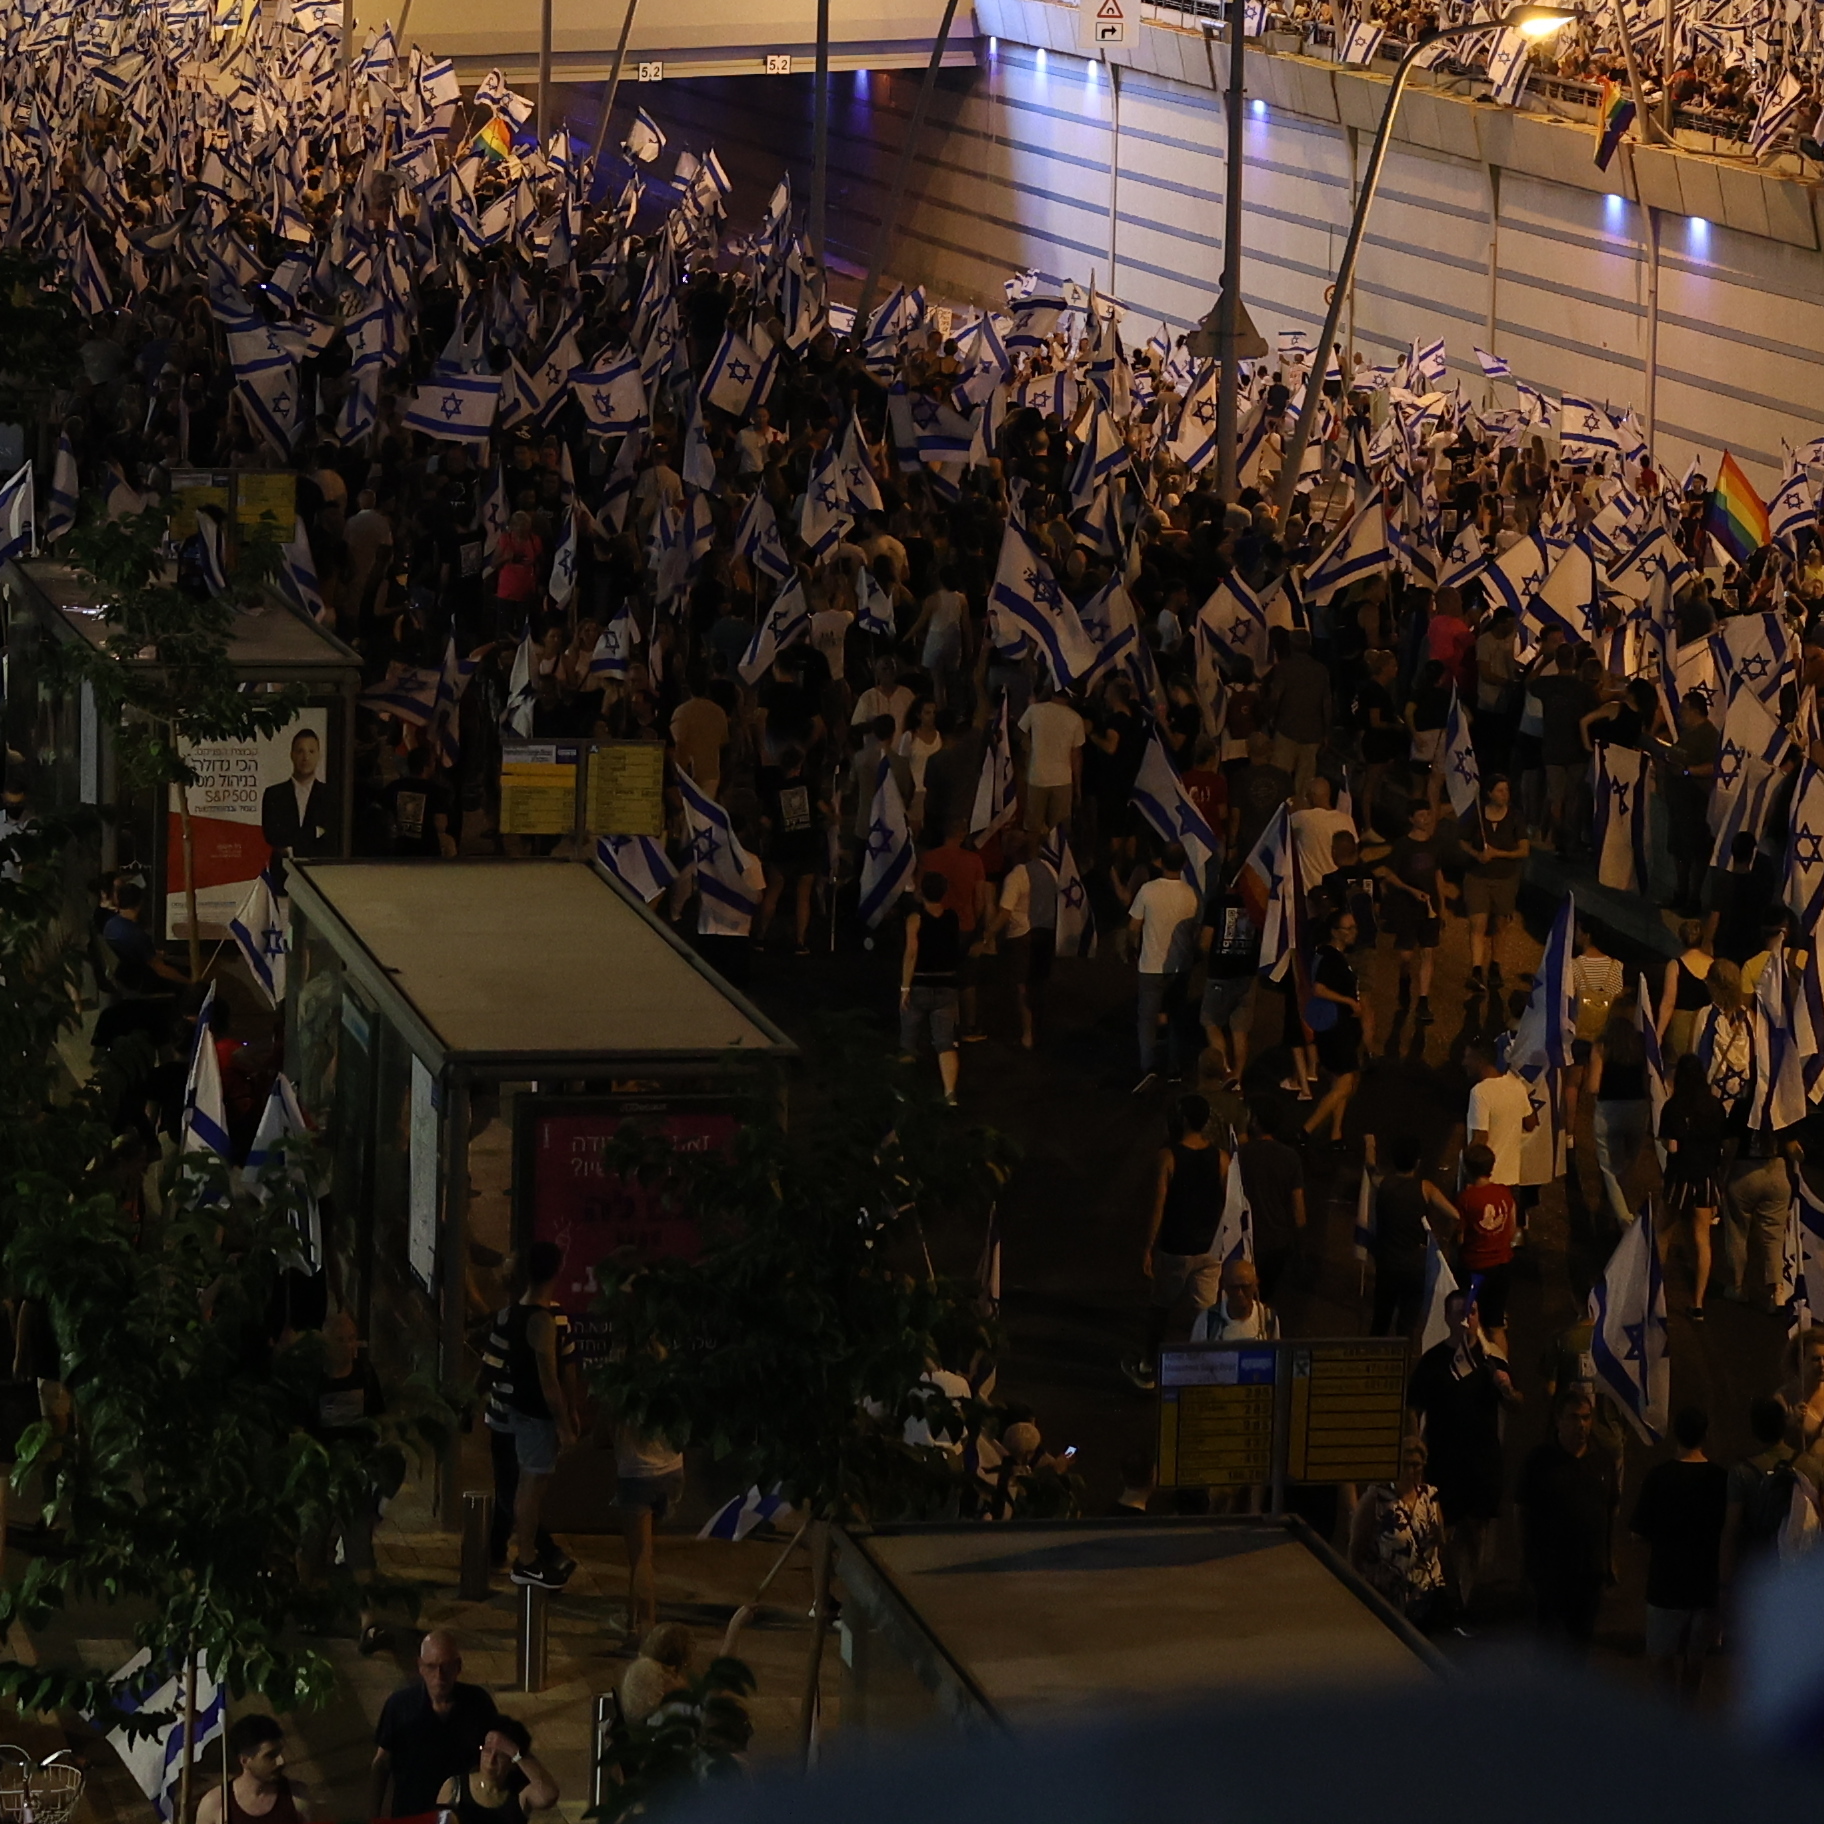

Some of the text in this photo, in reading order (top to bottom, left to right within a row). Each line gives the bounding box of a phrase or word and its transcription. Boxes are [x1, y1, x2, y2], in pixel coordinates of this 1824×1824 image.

[768, 59, 788, 71] 5.2
[641, 66, 660, 78] 5.2
[236, 759, 259, 772] הכי
[218, 773, 257, 788] בניהול
